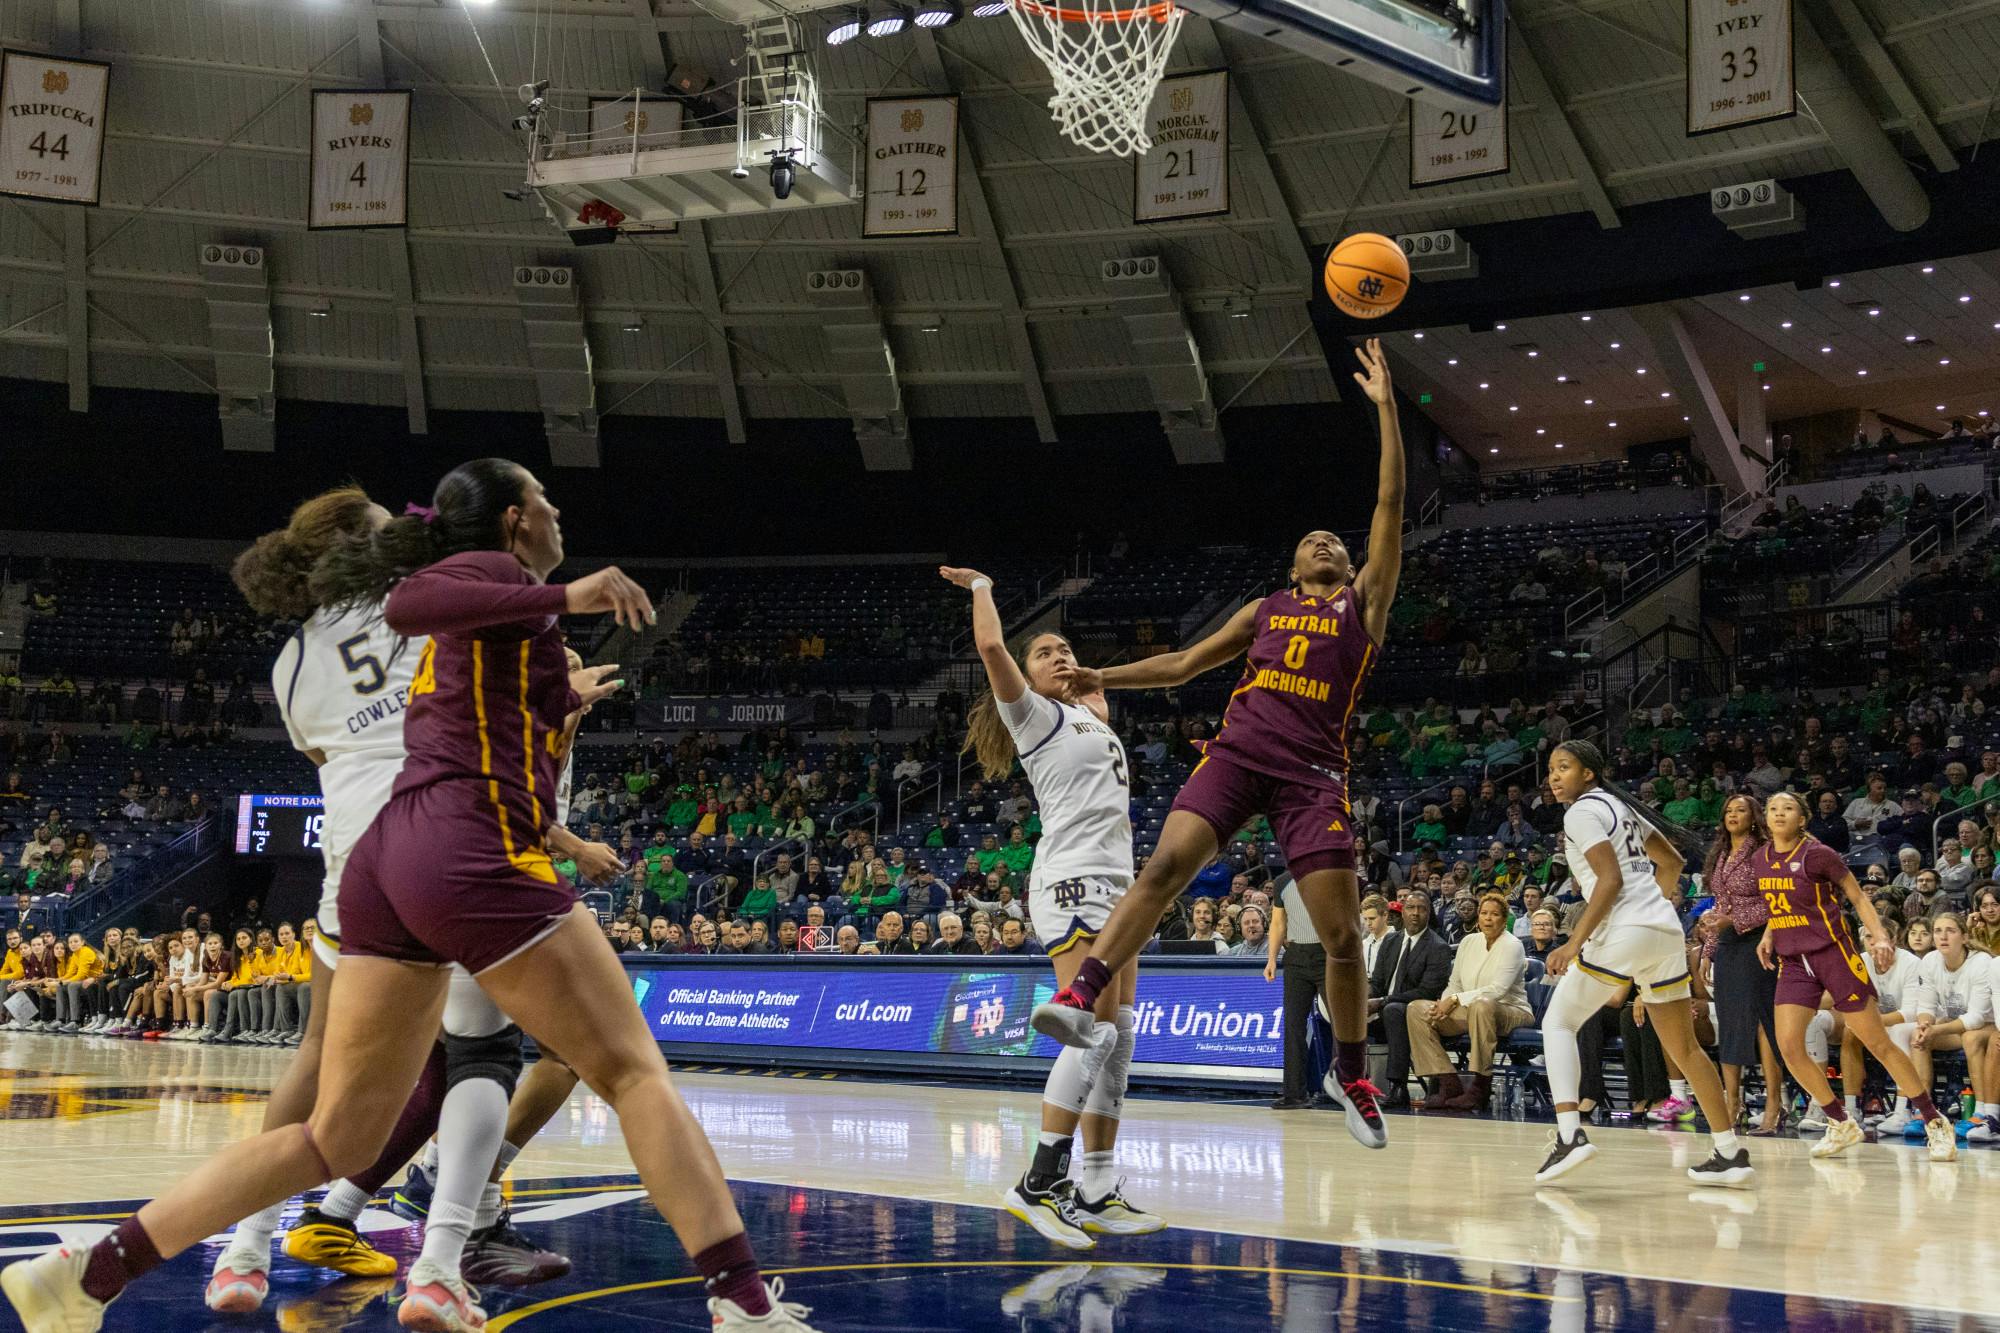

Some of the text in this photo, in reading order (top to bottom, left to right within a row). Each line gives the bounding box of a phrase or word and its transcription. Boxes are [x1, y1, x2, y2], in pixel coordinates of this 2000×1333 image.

[1714, 14, 1763, 37] IVEY
[1720, 46, 1758, 82] 33
[1710, 97, 1735, 112] 1996
[1746, 90, 1772, 105] 2001
[8, 103, 95, 128] TRIPUCKA
[1156, 114, 1209, 132] MORGAN-
[1440, 111, 1477, 140] 20
[29, 131, 69, 160] 44
[329, 135, 392, 151] RIVERS
[1151, 127, 1219, 147] UNNINGHAM
[875, 142, 946, 160] GAITHER
[1431, 153, 1454, 166] 1988
[1465, 147, 1488, 160] 1992
[350, 161, 367, 188] 4
[1164, 149, 1196, 179] 21
[16, 170, 41, 182] 1977
[53, 174, 78, 186] 1981
[895, 168, 927, 197] 12
[329, 202, 352, 212] 1984
[364, 201, 387, 211] 1988
[1154, 192, 1176, 204] 1993
[1187, 188, 1209, 200] 1997
[883, 210, 905, 220] 1993
[915, 208, 937, 218] 1997
[1269, 615, 1339, 637] CENTRAL
[1284, 634, 1310, 670] 0
[337, 631, 386, 696] 5
[1255, 669, 1330, 702] MICHIGAN
[664, 704, 785, 722] LUCI JORDYN
[1107, 741, 1128, 786] 2
[264, 796, 324, 806] NOTRE DAM
[258, 819, 265, 829] 4
[256, 837, 266, 852] 2
[1765, 892, 1792, 915] 24
[668, 988, 800, 1008] Official Banking Partner
[660, 1011, 790, 1029] of Notre Dame Athletics
[834, 1000, 912, 1022] cu1.com
[1169, 1002, 1264, 1038] Union
[1266, 1006, 1284, 1039] 1
[1004, 1026, 1025, 1039] VISA
